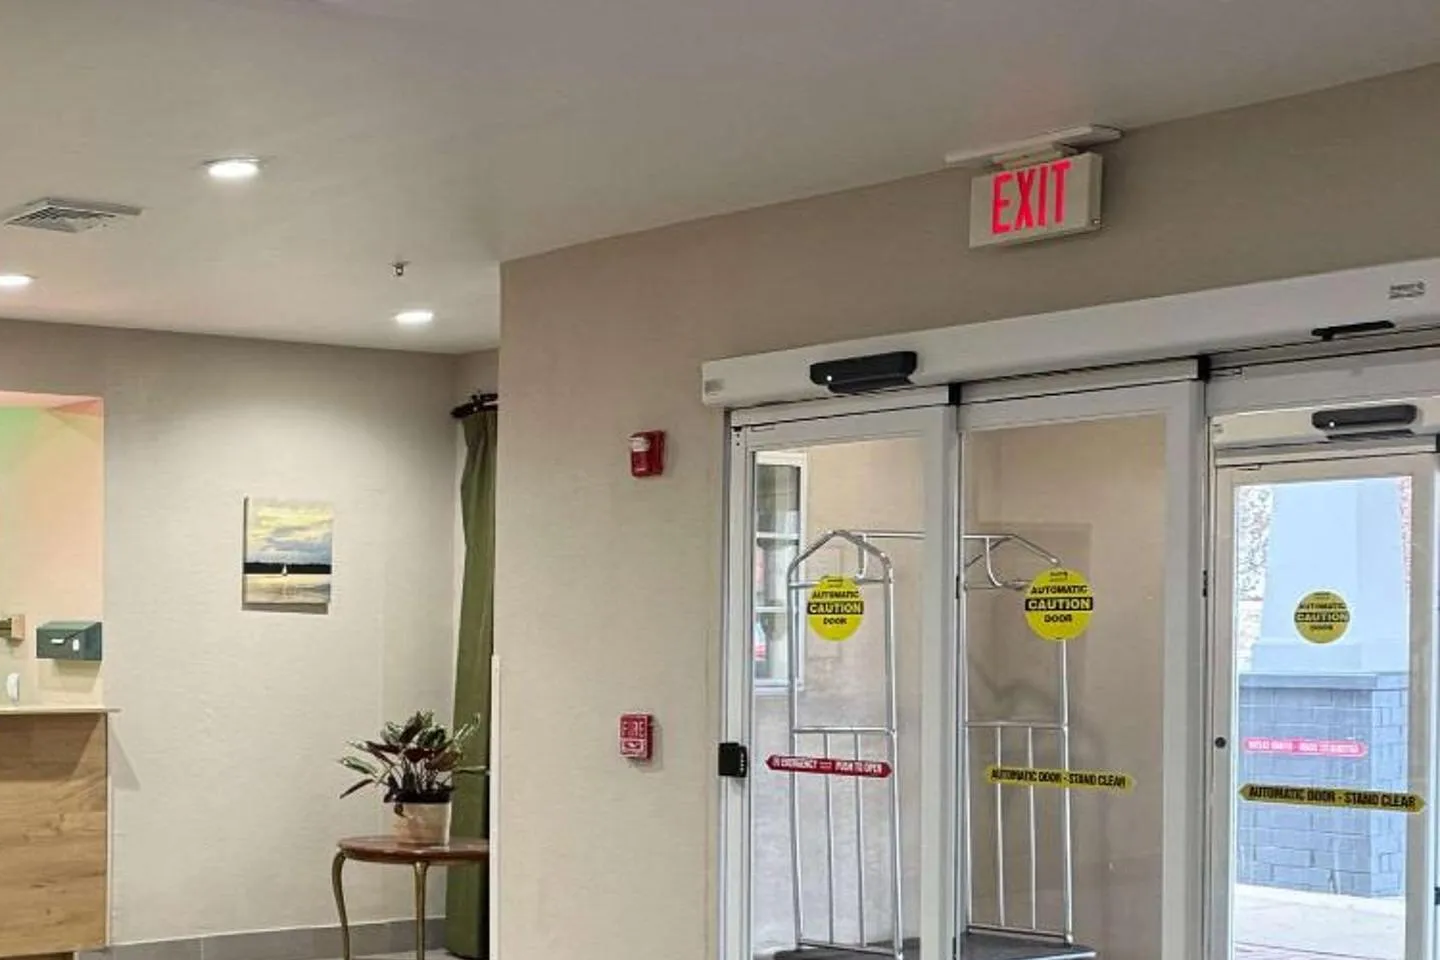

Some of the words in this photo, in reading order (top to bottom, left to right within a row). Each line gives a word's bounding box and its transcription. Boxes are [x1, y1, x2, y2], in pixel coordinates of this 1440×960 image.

[992, 159, 1072, 235] EXIT
[1030, 585, 1088, 594] AUTOMATIC
[809, 602, 861, 614] CAUTION
[1027, 598, 1091, 610] CAUTION
[1044, 614, 1073, 623] DOOR
[1296, 612, 1348, 622] CAUTION
[991, 769, 1037, 782] AUTOMATIC
[1039, 771, 1062, 783] DOOR
[1069, 773, 1096, 785] STAND
[1098, 775, 1126, 788] CLEAR
[1249, 786, 1305, 800] AUTOMATIC
[1307, 790, 1336, 803] DOOR
[1345, 792, 1379, 806] STAND
[1381, 794, 1417, 809] CLEAR
